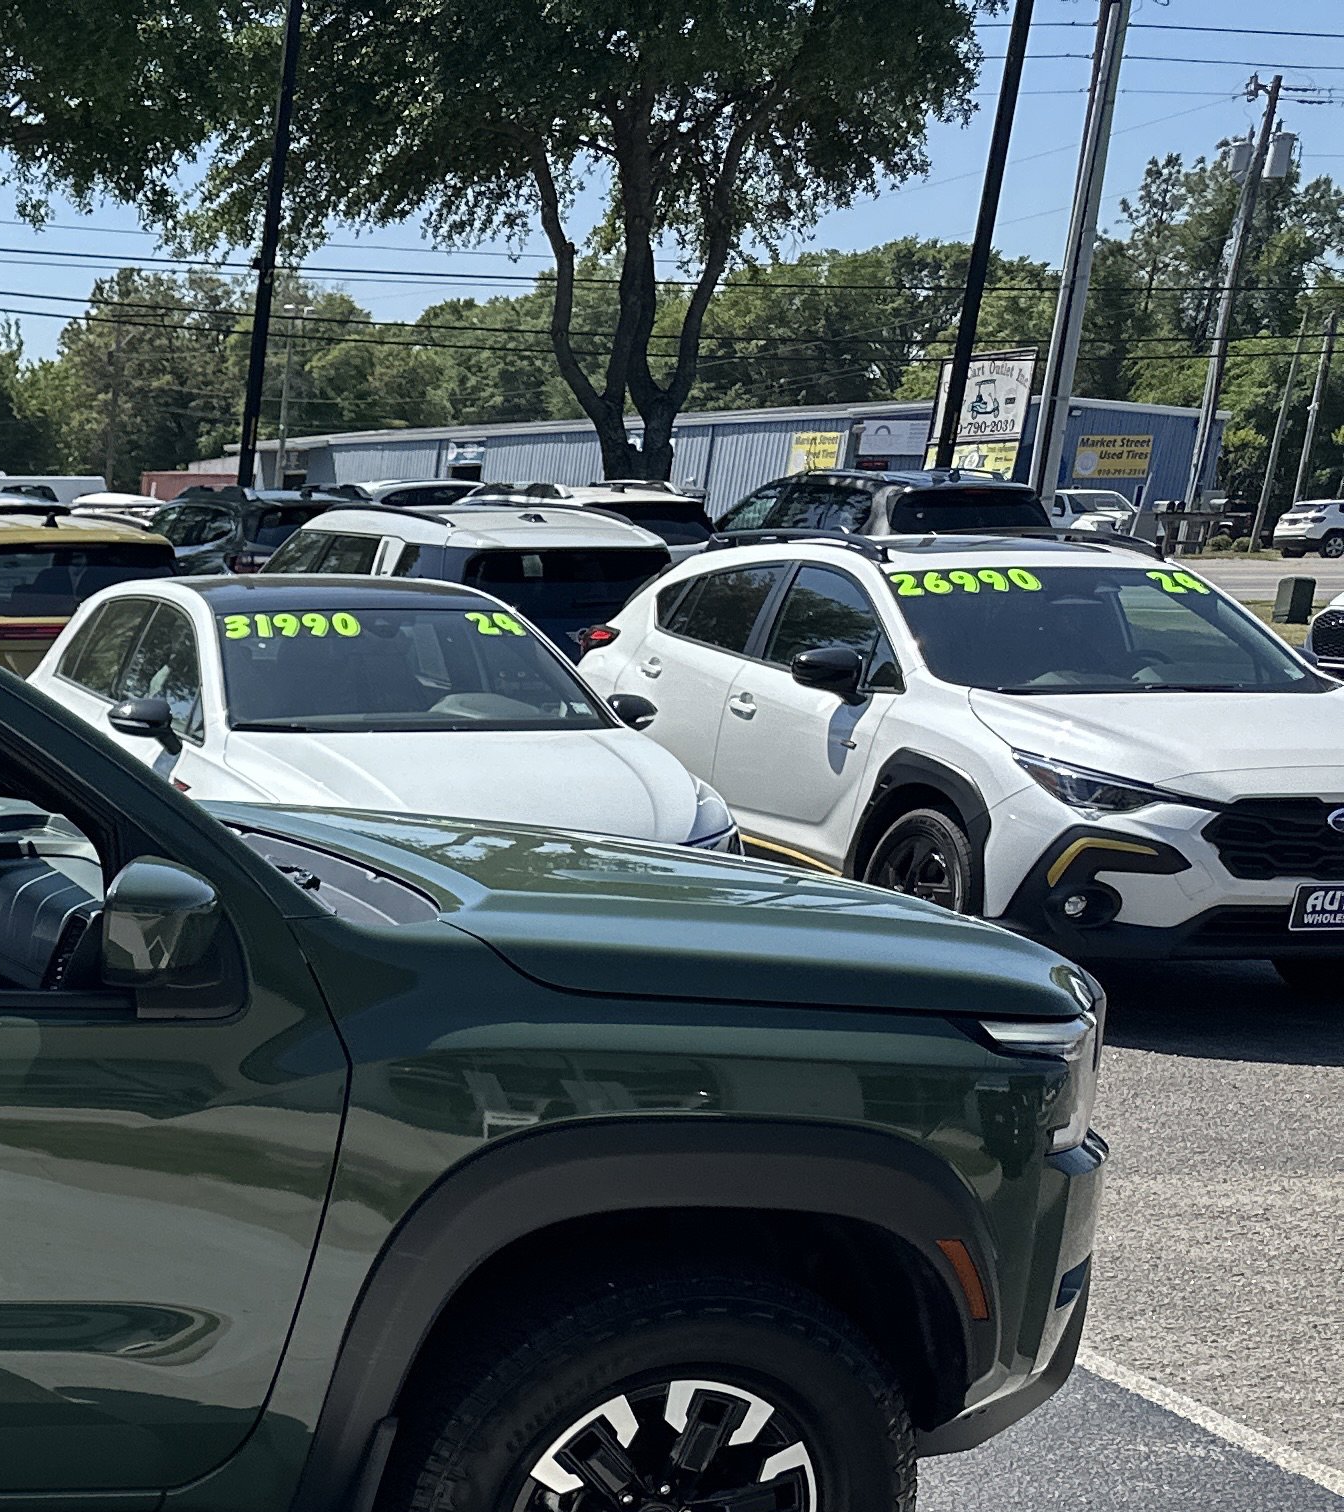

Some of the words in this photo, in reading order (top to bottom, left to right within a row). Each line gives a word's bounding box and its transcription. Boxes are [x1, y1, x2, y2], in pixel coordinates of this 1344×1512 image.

[1079, 438, 1117, 447] Market
[1119, 438, 1151, 447] Street
[1099, 450, 1123, 459] Used
[1126, 450, 1148, 459] Tires
[889, 568, 1043, 597] 26990
[1146, 571, 1210, 595] 24
[223, 611, 361, 639] 31990
[464, 612, 527, 637] 24
